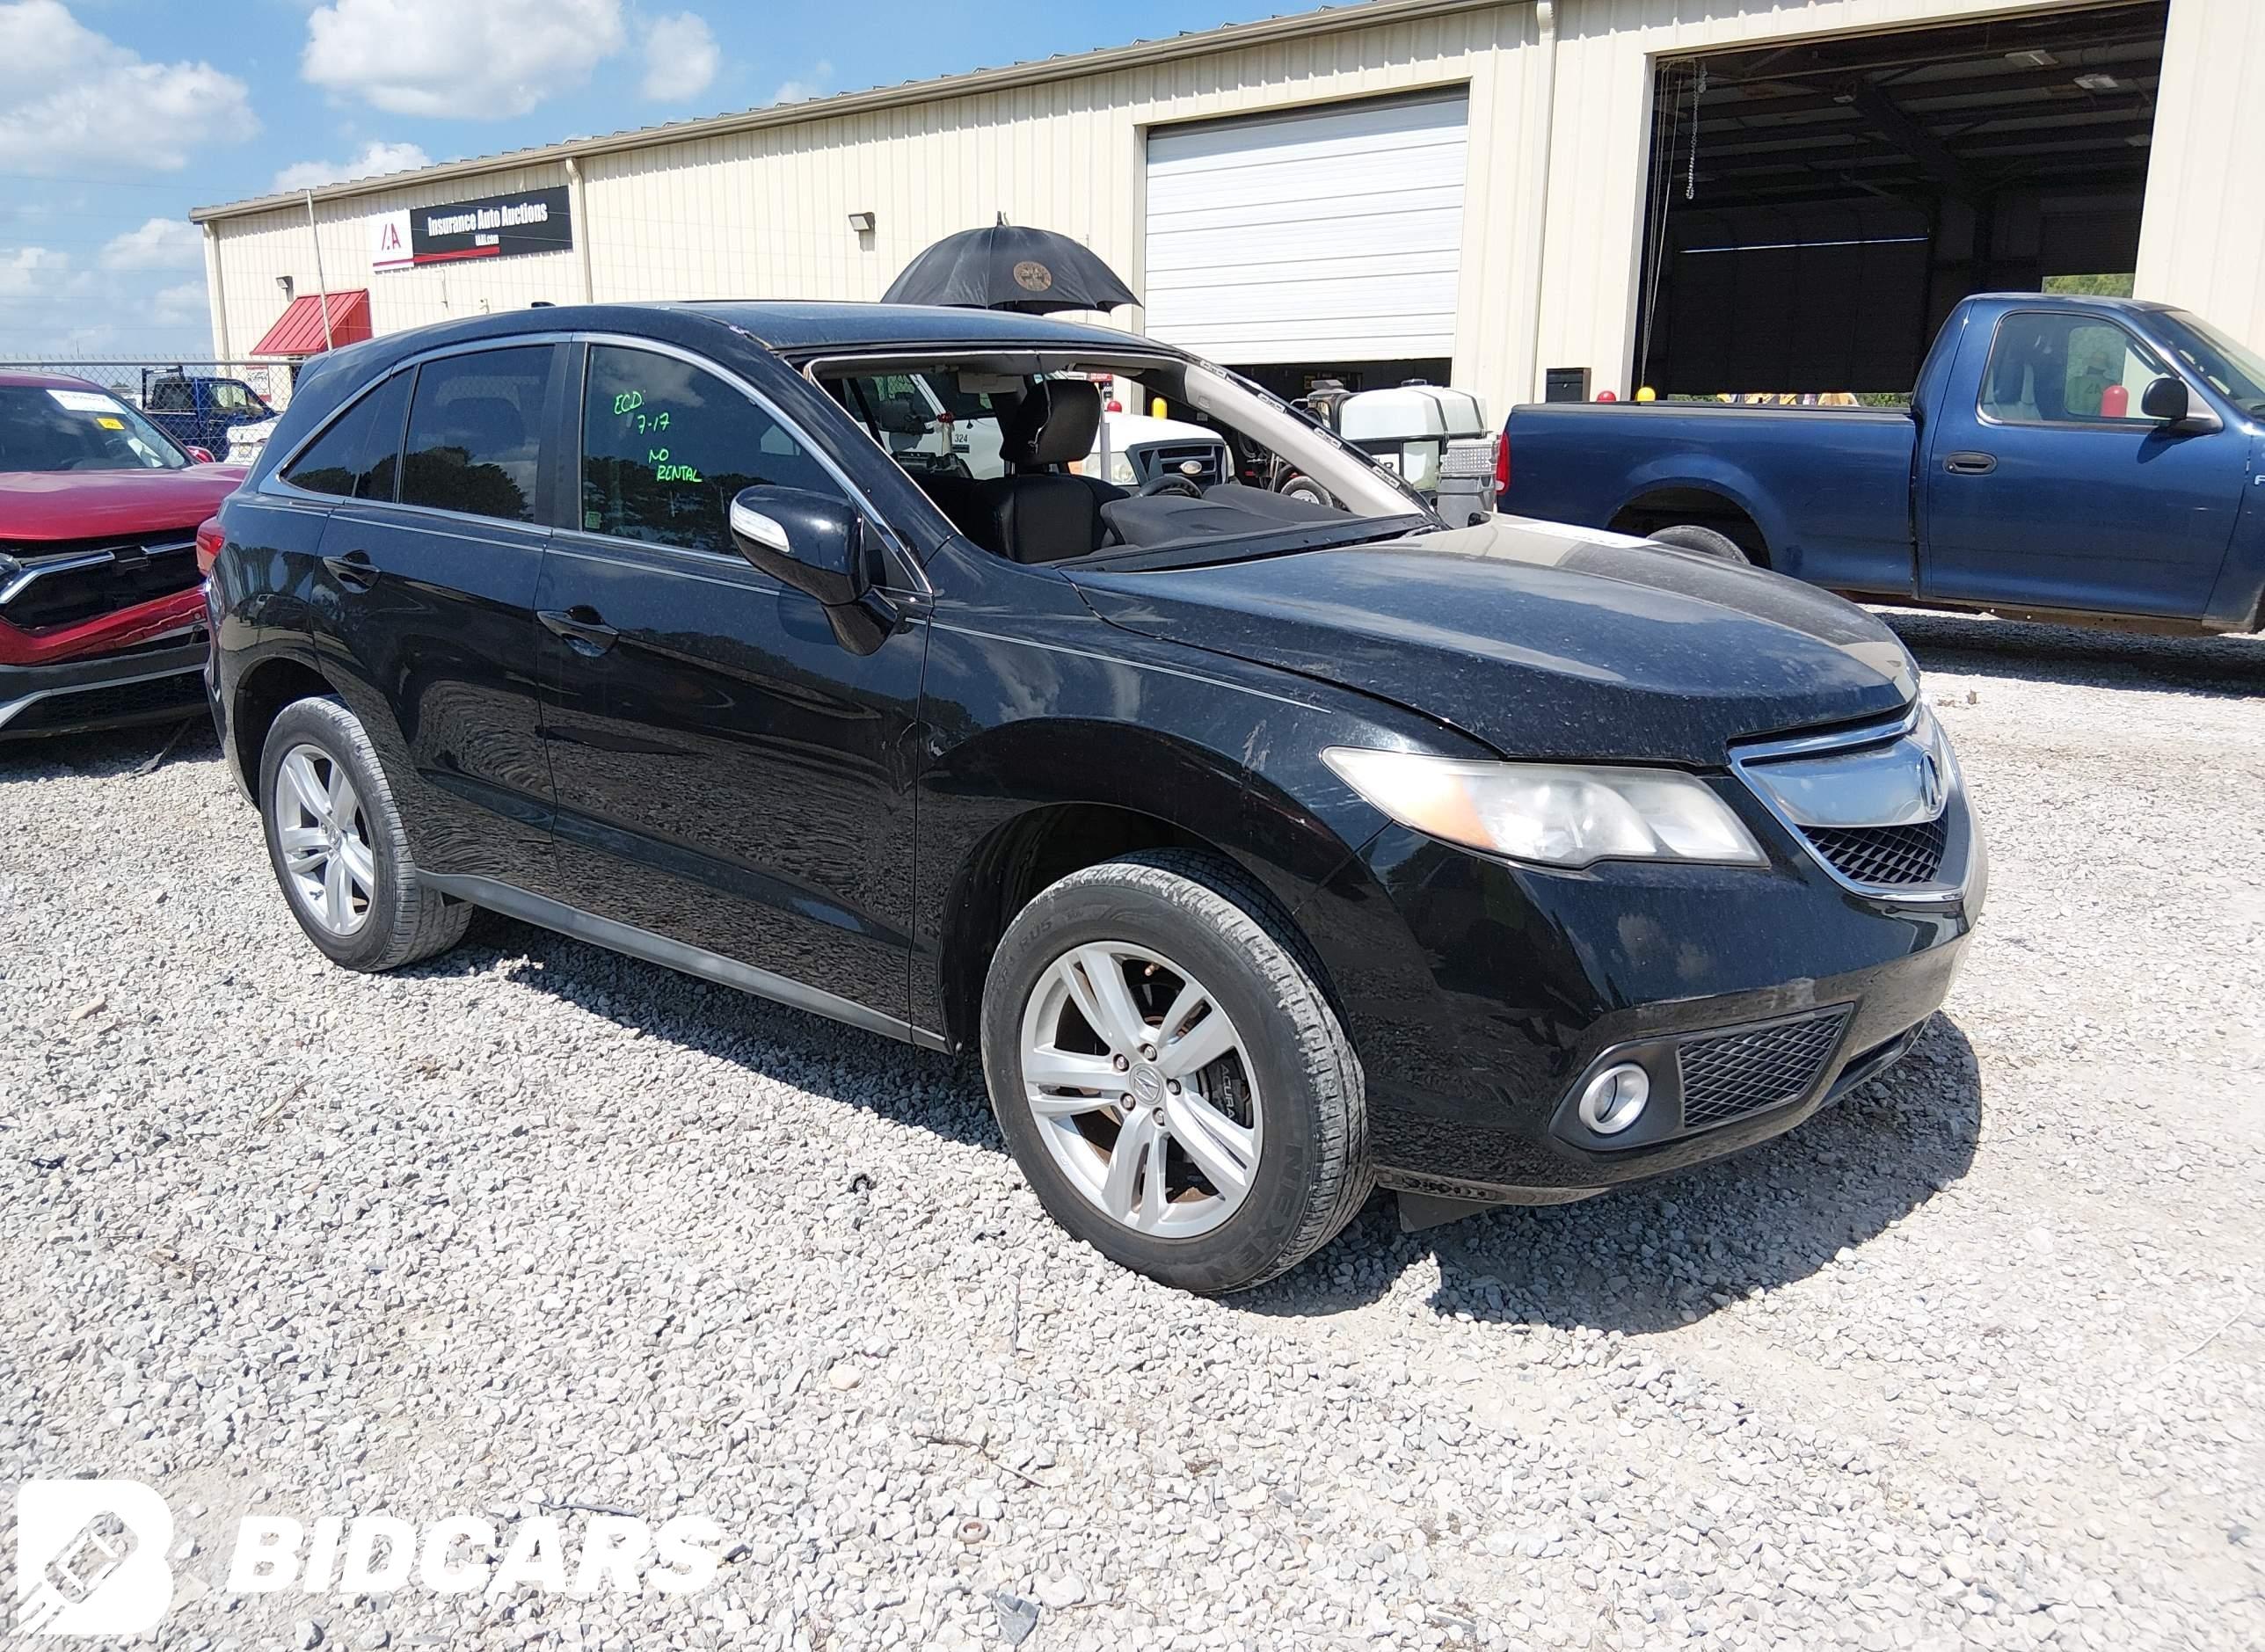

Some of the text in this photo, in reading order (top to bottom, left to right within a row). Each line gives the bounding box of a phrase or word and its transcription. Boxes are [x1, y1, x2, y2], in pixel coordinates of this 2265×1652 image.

[428, 202, 548, 237] Insurance Auto Auctions
[648, 448, 669, 463] NO
[656, 465, 703, 483] RENTAL
[1220, 1063, 1235, 1118] ACURA
